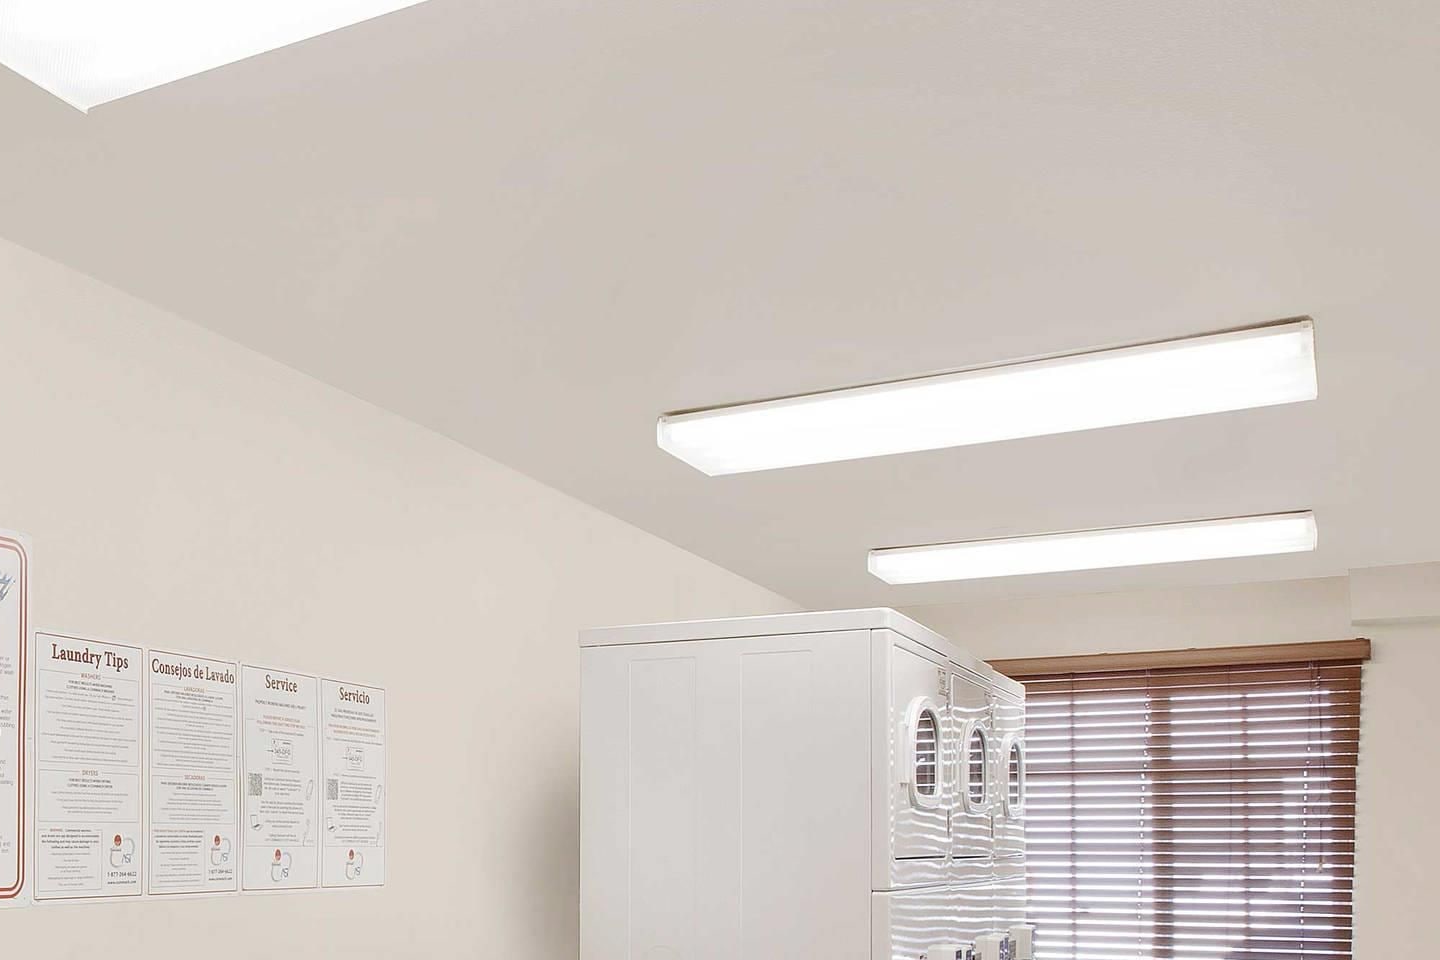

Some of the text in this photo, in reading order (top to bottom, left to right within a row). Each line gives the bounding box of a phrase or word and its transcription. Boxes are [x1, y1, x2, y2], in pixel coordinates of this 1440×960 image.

[52, 643, 128, 672] Laundry Tips
[152, 659, 234, 684] Consejos de Lavado
[265, 674, 297, 692] Service
[339, 687, 369, 704] Servicio
